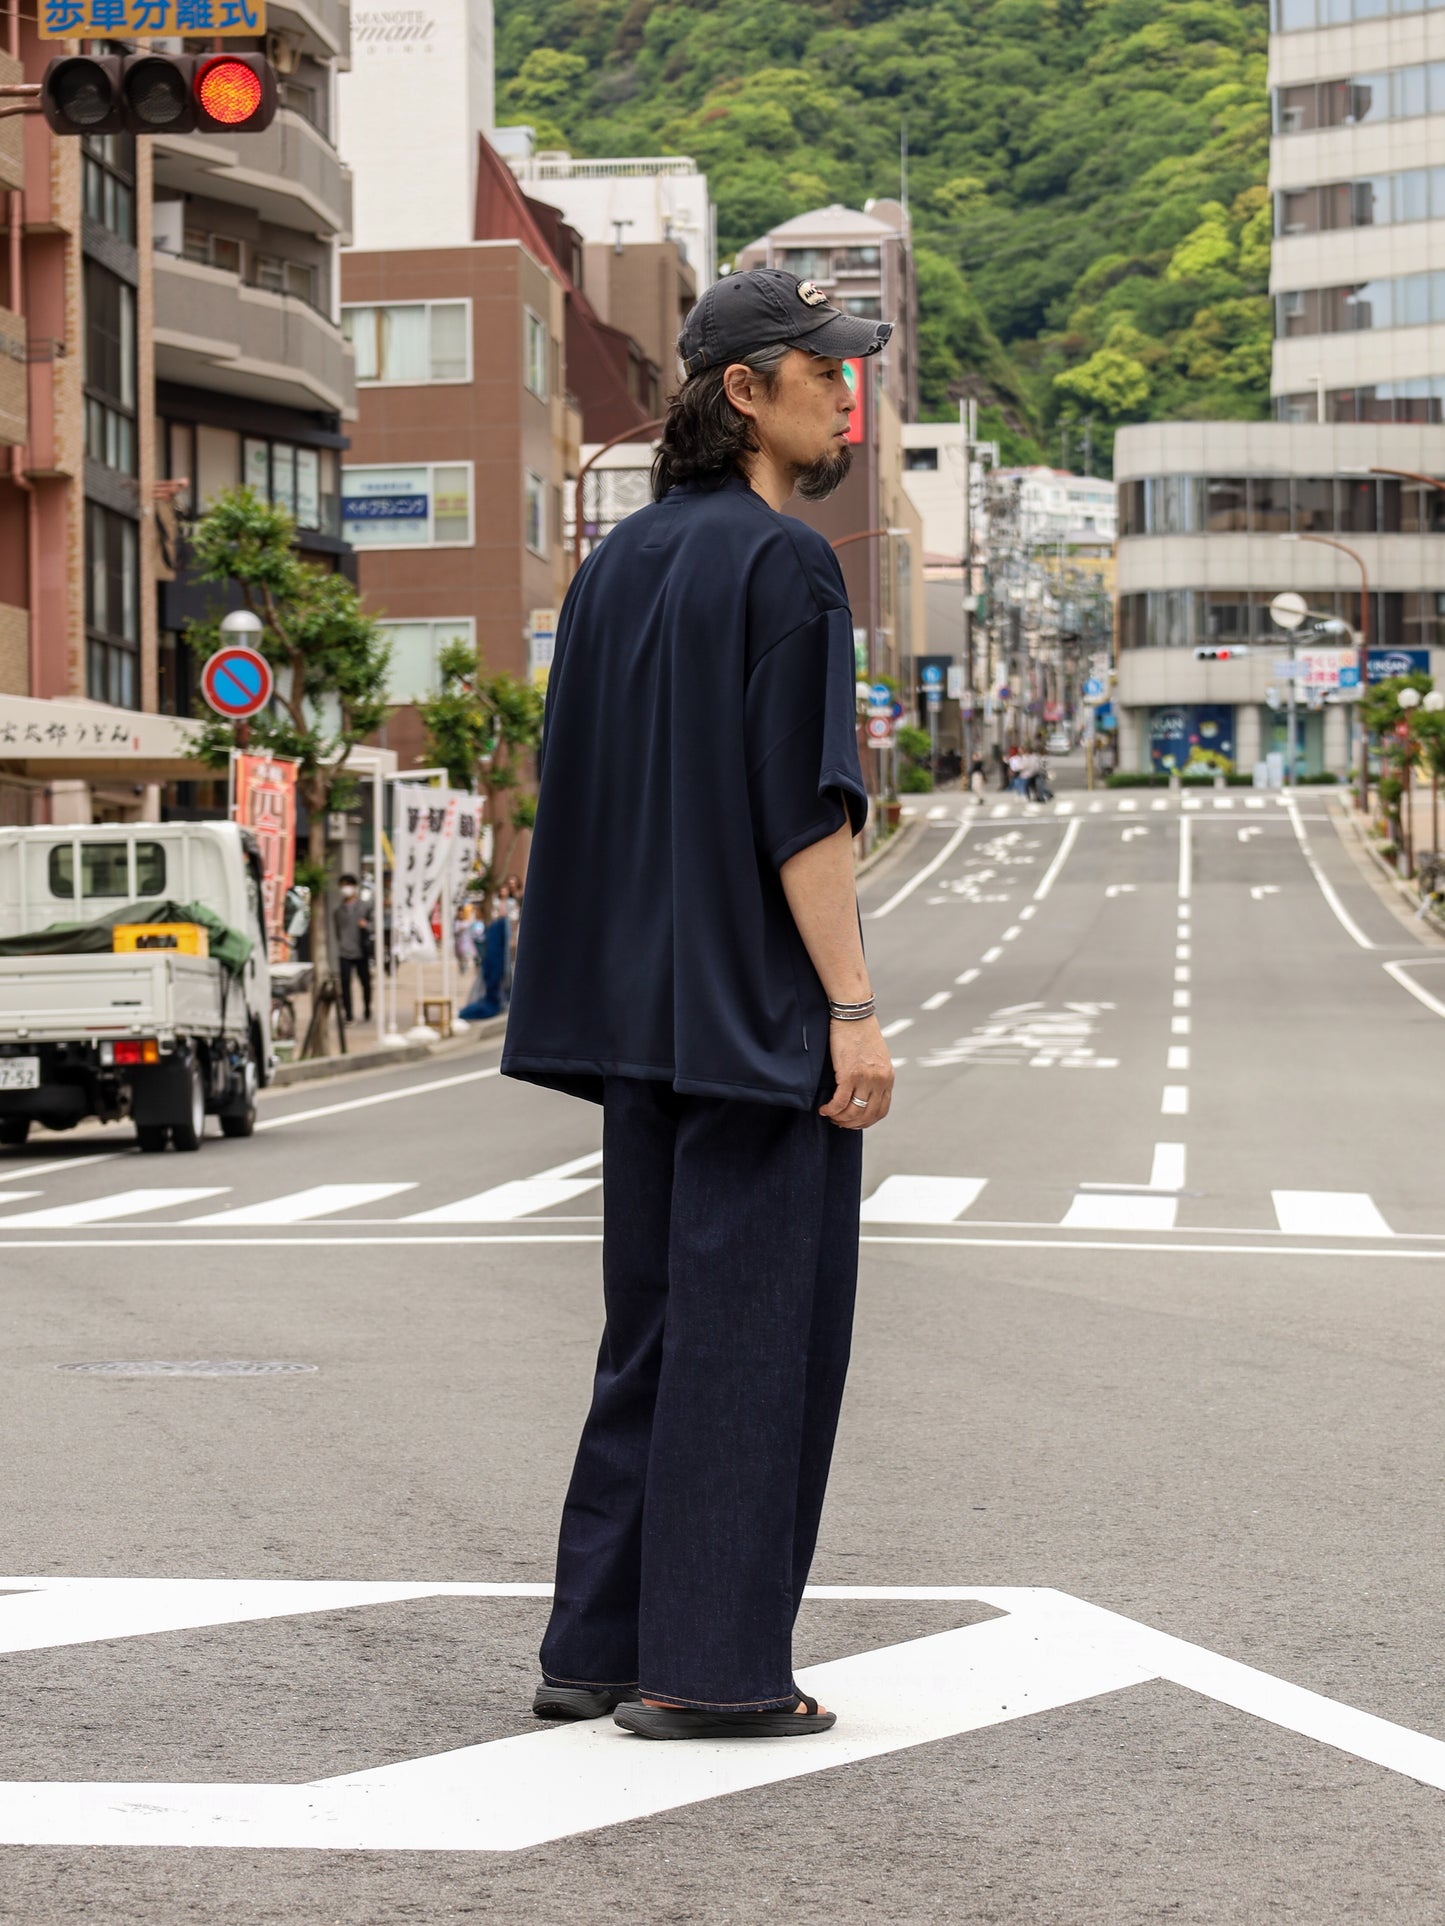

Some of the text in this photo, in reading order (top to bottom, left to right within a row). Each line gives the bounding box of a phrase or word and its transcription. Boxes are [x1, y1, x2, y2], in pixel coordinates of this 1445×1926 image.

[45, 0, 257, 32] 歩車分離式
